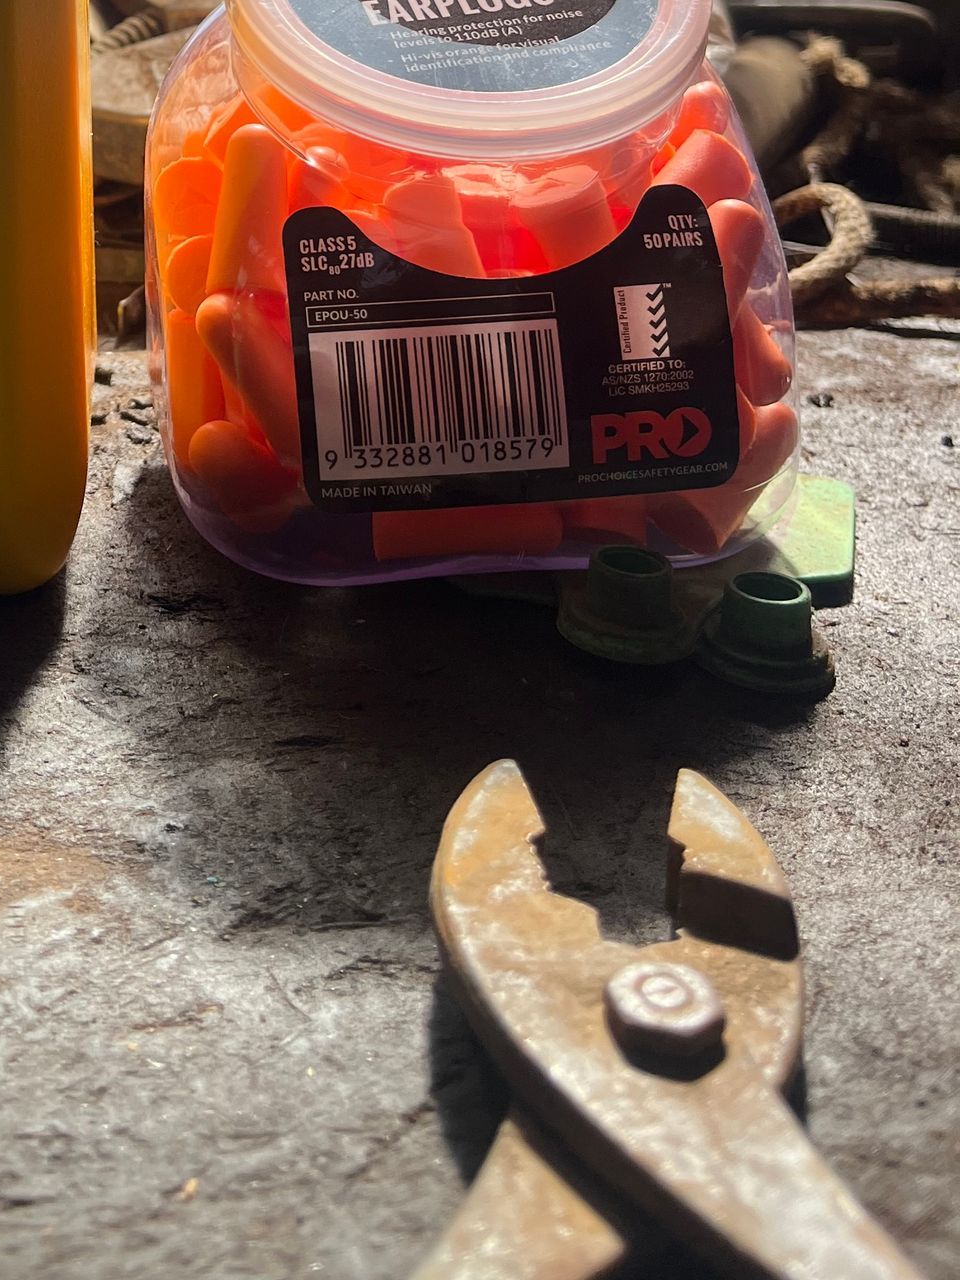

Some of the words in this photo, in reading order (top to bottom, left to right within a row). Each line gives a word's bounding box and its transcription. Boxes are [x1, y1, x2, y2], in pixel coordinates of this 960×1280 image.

[390, 24, 447, 40] Hearing
[447, 18, 521, 37] protection
[522, 13, 543, 25] for
[545, 9, 583, 20] noise
[393, 36, 435, 49] levels
[438, 35, 453, 44] to
[456, 28, 500, 42] 110dB
[501, 25, 523, 38] (A)
[400, 51, 443, 63] Hi-vis
[445, 44, 495, 59] orange
[516, 36, 560, 49] visual
[405, 53, 503, 72] identification
[532, 40, 613, 56] compliance
[667, 214, 699, 230] QTY:
[300, 236, 346, 254] CLASS
[347, 235, 356, 251] 5
[643, 233, 661, 249] 50
[663, 232, 703, 248] PAIRS
[304, 290, 334, 302] PART
[337, 288, 359, 299] NO.
[617, 289, 628, 320] Product
[315, 309, 368, 321] EPOU-50
[621, 321, 632, 354] Certified
[608, 361, 665, 374] CERTIFIED
[667, 360, 686, 370] TO:
[602, 373, 641, 386] AS/NZS
[644, 370, 694, 383] 1270:2002
[608, 386, 627, 397] LIC
[590, 406, 712, 465] PRO
[353, 445, 446, 469] 332881
[461, 438, 554, 463] 018579
[578, 461, 729, 484] PROCHOICESAFETYGEAR.COM
[321, 484, 361, 499] MADE
[364, 484, 377, 497] IN
[380, 483, 432, 496] TAIWAN
